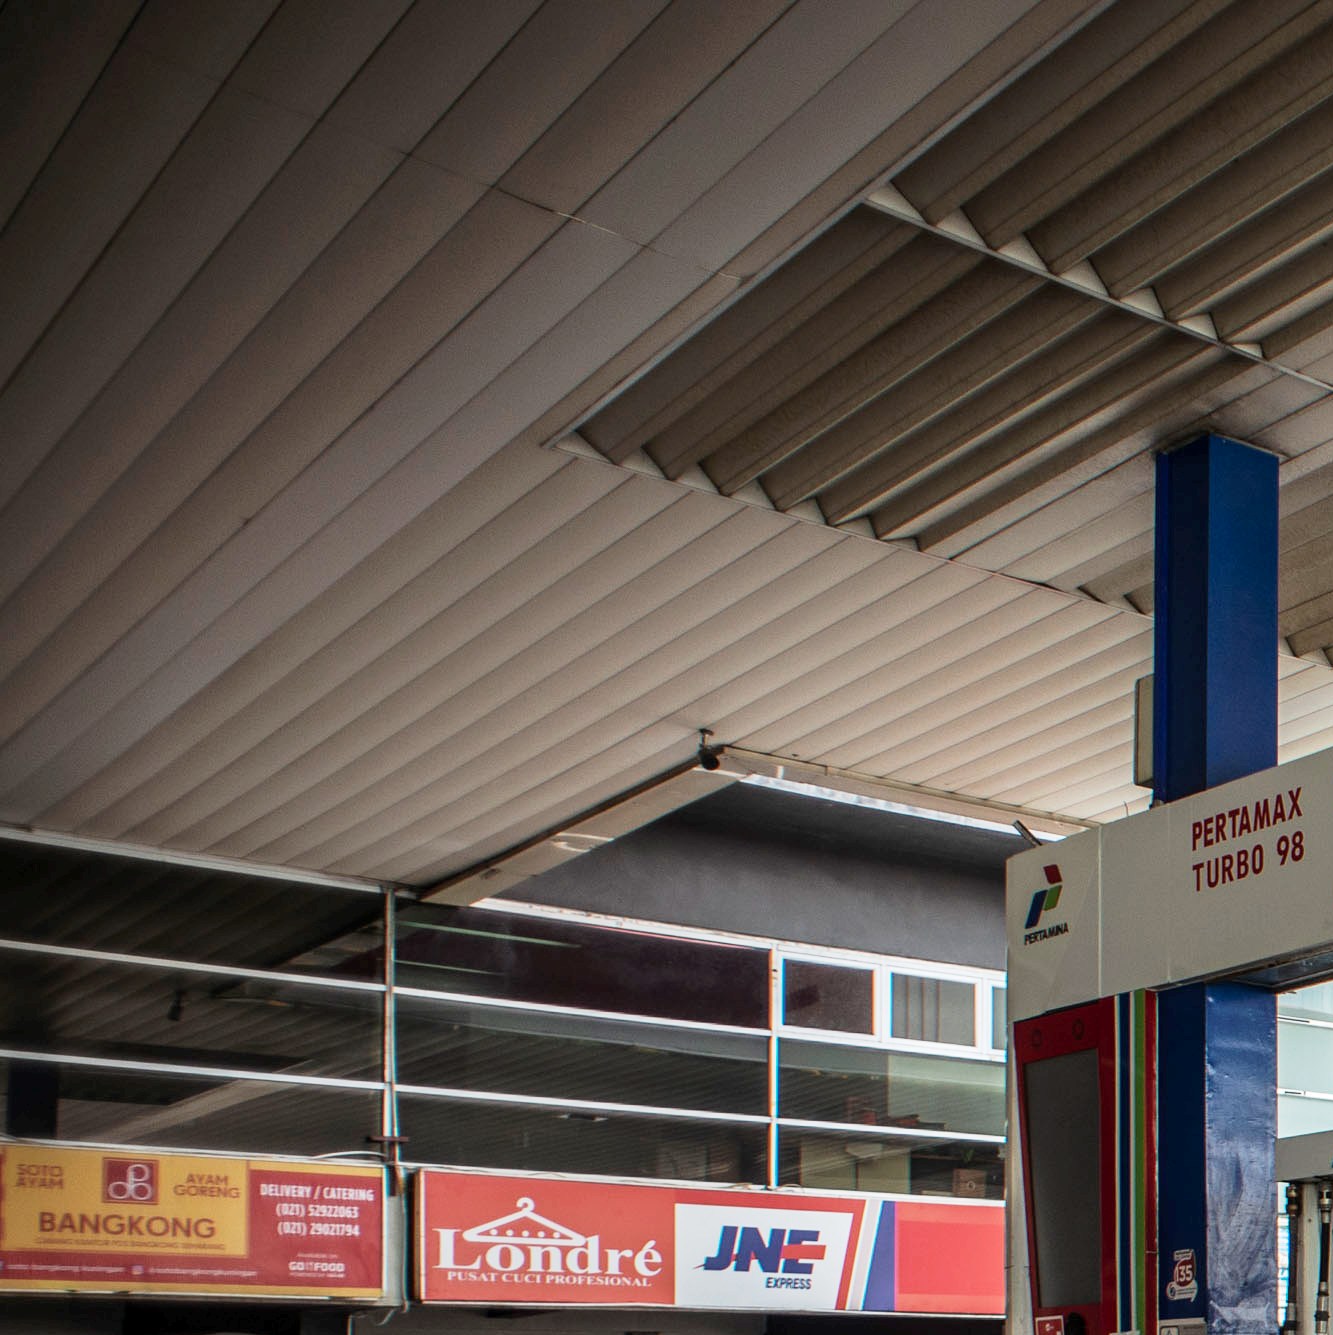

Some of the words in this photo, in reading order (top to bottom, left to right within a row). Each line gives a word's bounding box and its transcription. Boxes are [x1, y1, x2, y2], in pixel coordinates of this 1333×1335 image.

[1192, 788, 1302, 851] PERTAMAX
[1193, 849, 1264, 892] TURBO
[1276, 830, 1305, 866] 98
[1023, 922, 1069, 945] PERTAMINA
[17, 1163, 64, 1177] SOTO
[16, 1177, 64, 1189] AYAM
[186, 1173, 229, 1185] AYAM
[173, 1184, 240, 1199] GORENG
[260, 1184, 312, 1198] DELIVERY
[313, 1186, 321, 1200] /
[323, 1187, 375, 1201] CATERING
[276, 1203, 306, 1217] (021)
[38, 1211, 216, 1239] BANGKONG
[277, 1221, 307, 1236] (021)
[432, 1228, 663, 1277] Londré
[701, 1224, 827, 1273] JNE
[447, 1271, 499, 1283] PUSAT
[502, 1273, 542, 1284] CUCI
[546, 1275, 652, 1287] PROFESIONAL
[1175, 1264, 1193, 1282] 135
[765, 1276, 812, 1291] EXPRESS
